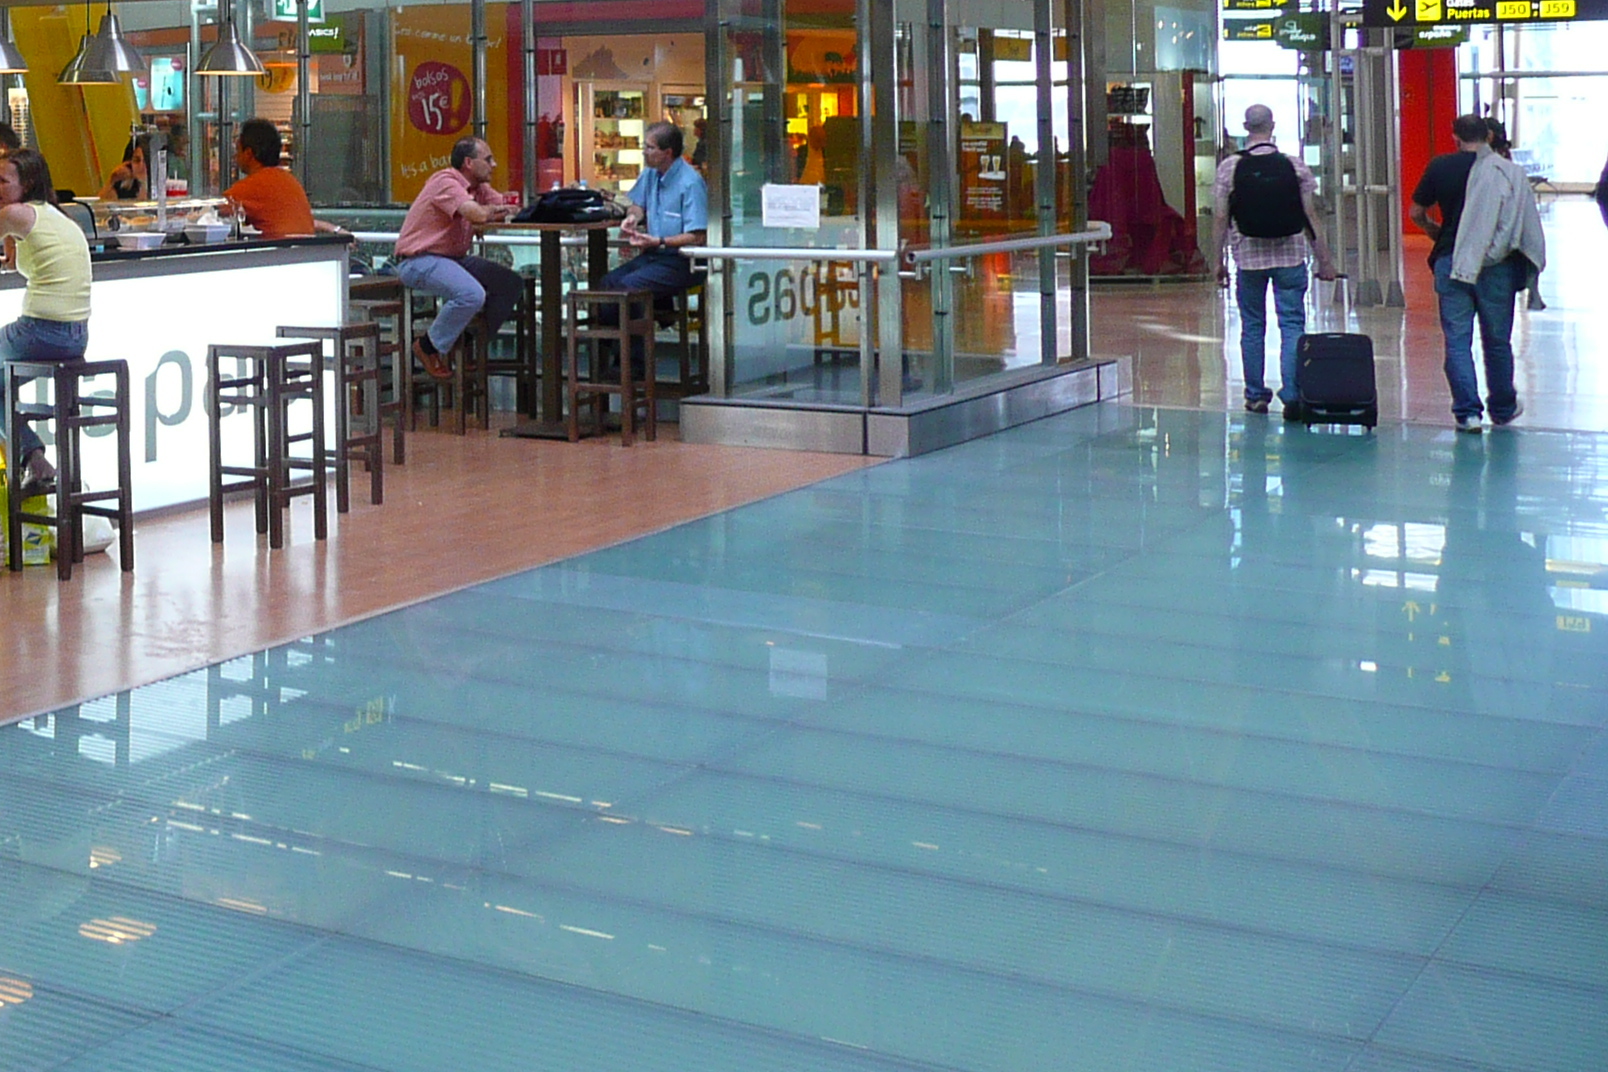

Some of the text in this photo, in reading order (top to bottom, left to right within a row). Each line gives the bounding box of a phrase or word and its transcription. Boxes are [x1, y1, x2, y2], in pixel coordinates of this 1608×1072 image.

[1447, 7, 1491, 20] Puertas
[1500, 4, 1527, 16] J50
[1545, 2, 1571, 14] J59
[413, 67, 449, 89] bolsos
[421, 92, 450, 131] 15€
